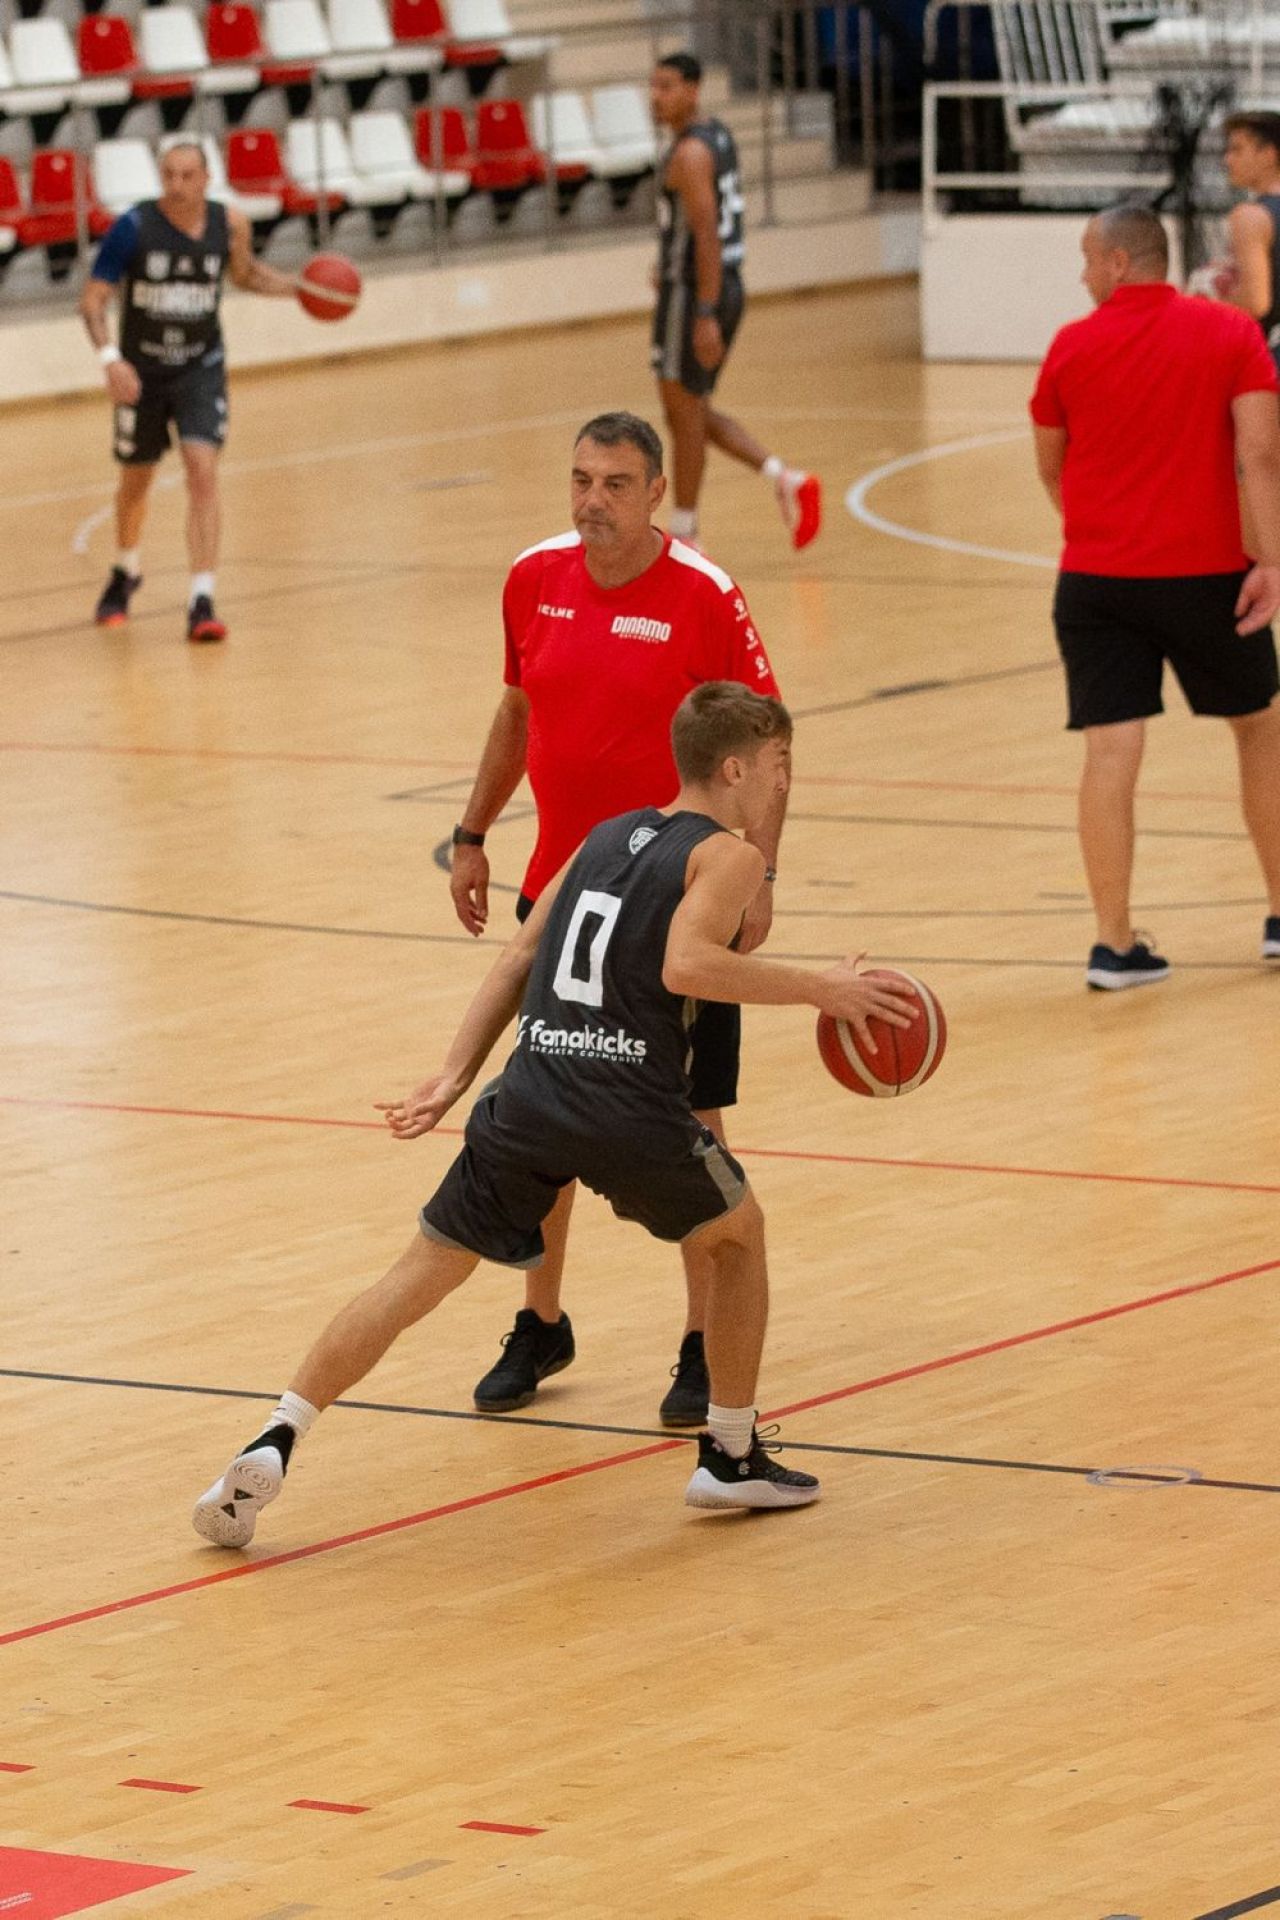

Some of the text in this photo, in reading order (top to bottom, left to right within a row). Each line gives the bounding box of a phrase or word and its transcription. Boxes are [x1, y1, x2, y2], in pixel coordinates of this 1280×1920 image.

[610, 615, 672, 642] DINAMO
[552, 889, 623, 1007] 0
[530, 1019, 646, 1057] fanakicks
